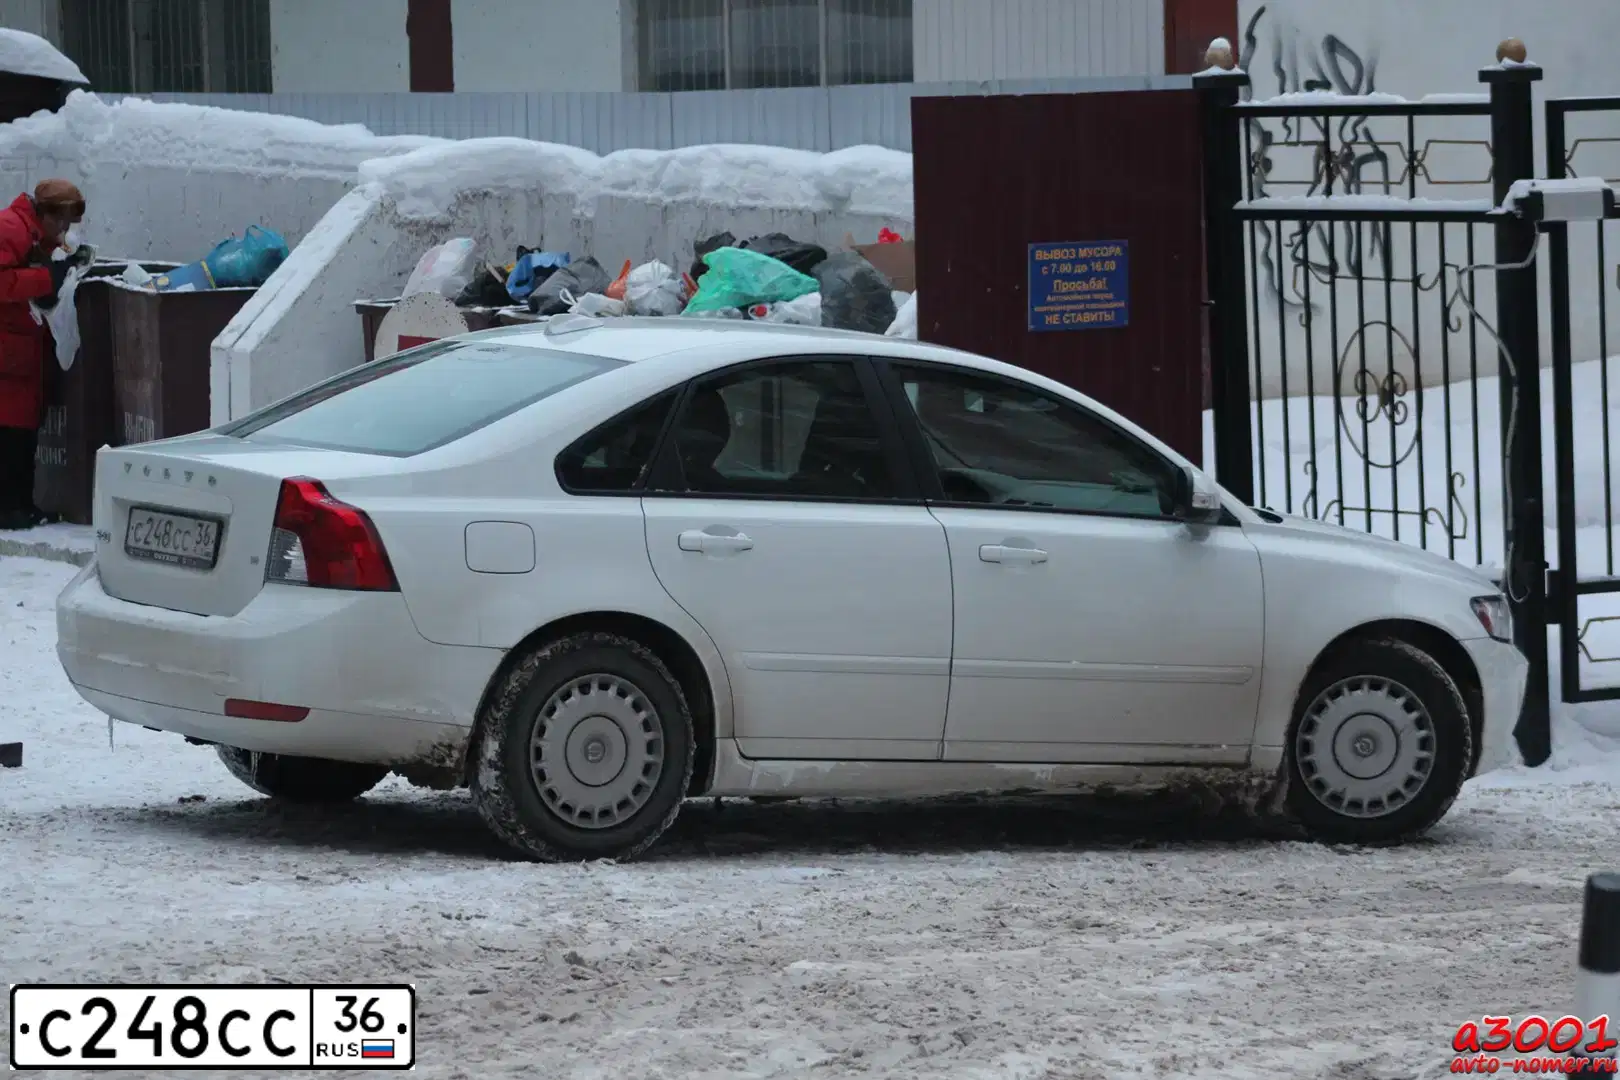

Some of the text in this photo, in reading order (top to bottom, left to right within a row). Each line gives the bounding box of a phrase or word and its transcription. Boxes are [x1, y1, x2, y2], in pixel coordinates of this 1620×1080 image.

[1035, 246, 1122, 260] ВЫВОЗ МУСОРА
[1073, 264, 1088, 274] до
[1053, 277, 1107, 292] Просьба!
[1045, 310, 1115, 324] НЕ СТАВИТЬ!
[194, 522, 211, 547] 36
